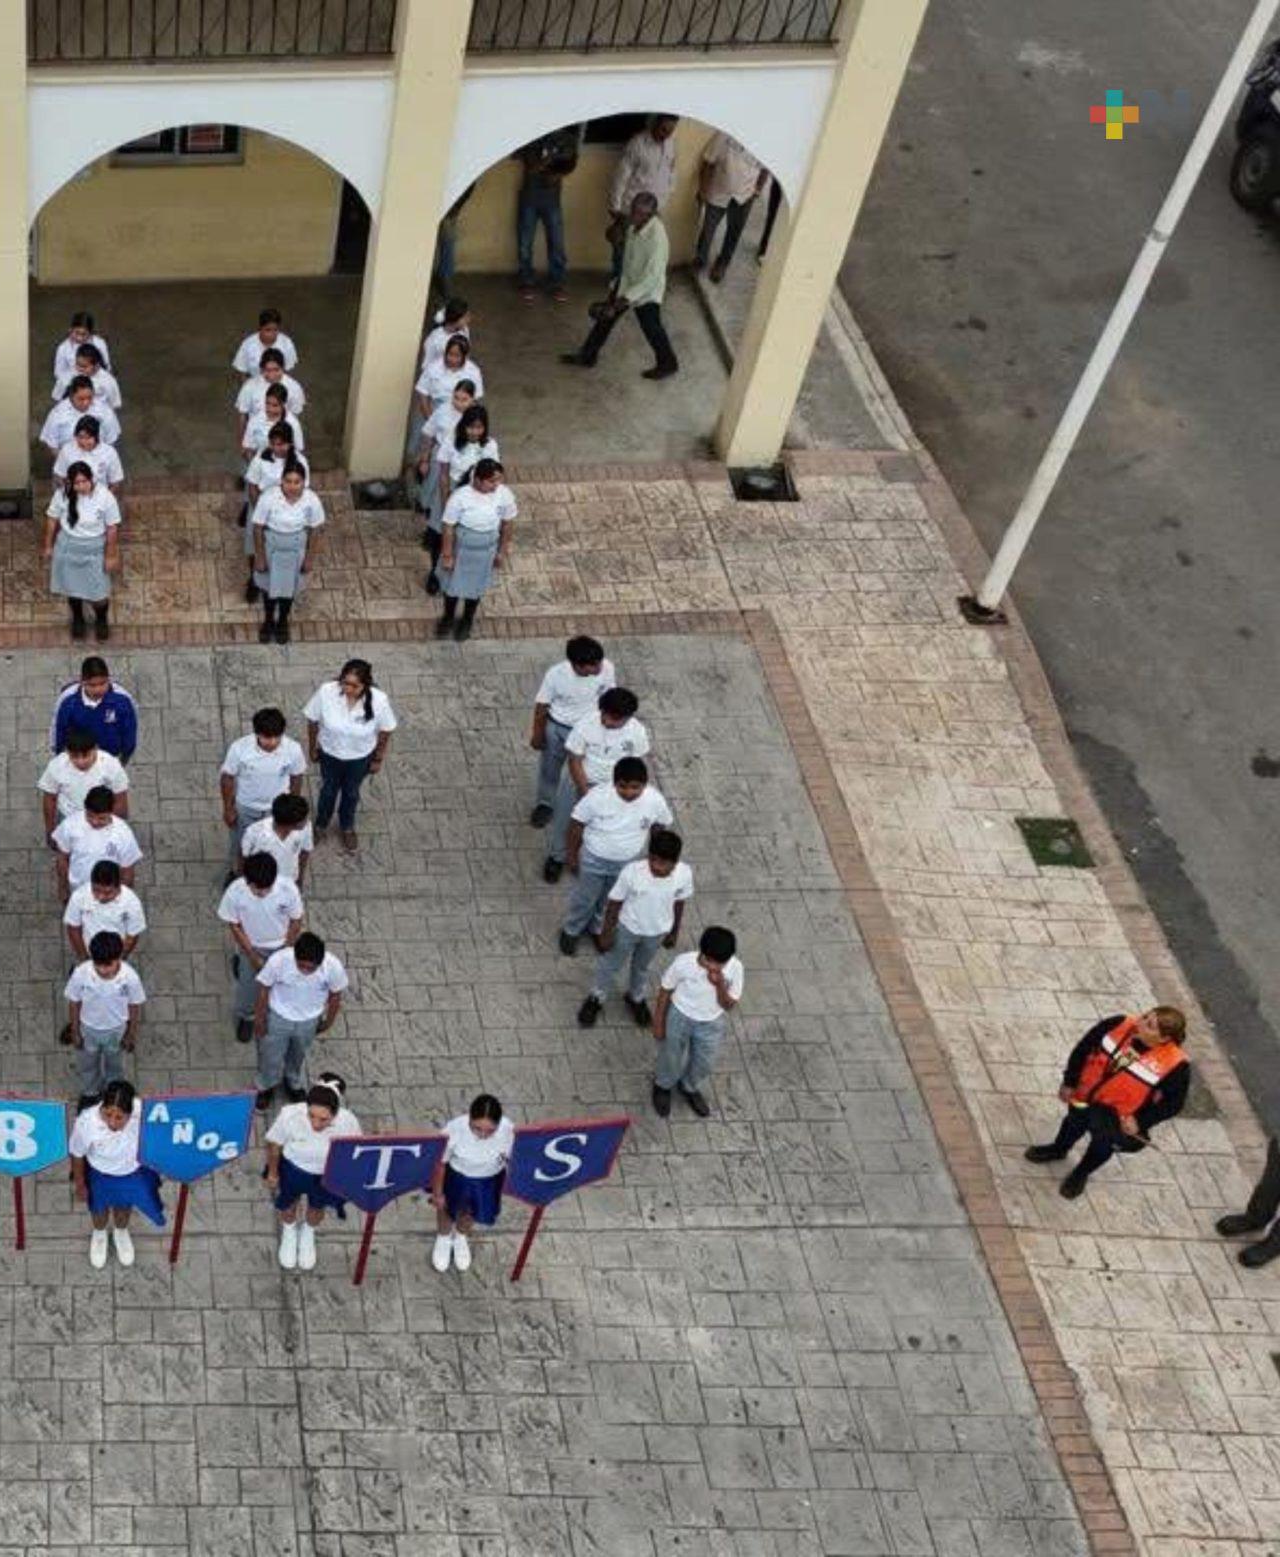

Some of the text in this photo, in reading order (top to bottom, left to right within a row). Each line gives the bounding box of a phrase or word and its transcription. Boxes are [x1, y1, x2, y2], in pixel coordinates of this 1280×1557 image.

[147, 1102, 239, 1160] AÑOS
[352, 1143, 422, 1190] T
[534, 1132, 588, 1182] S
